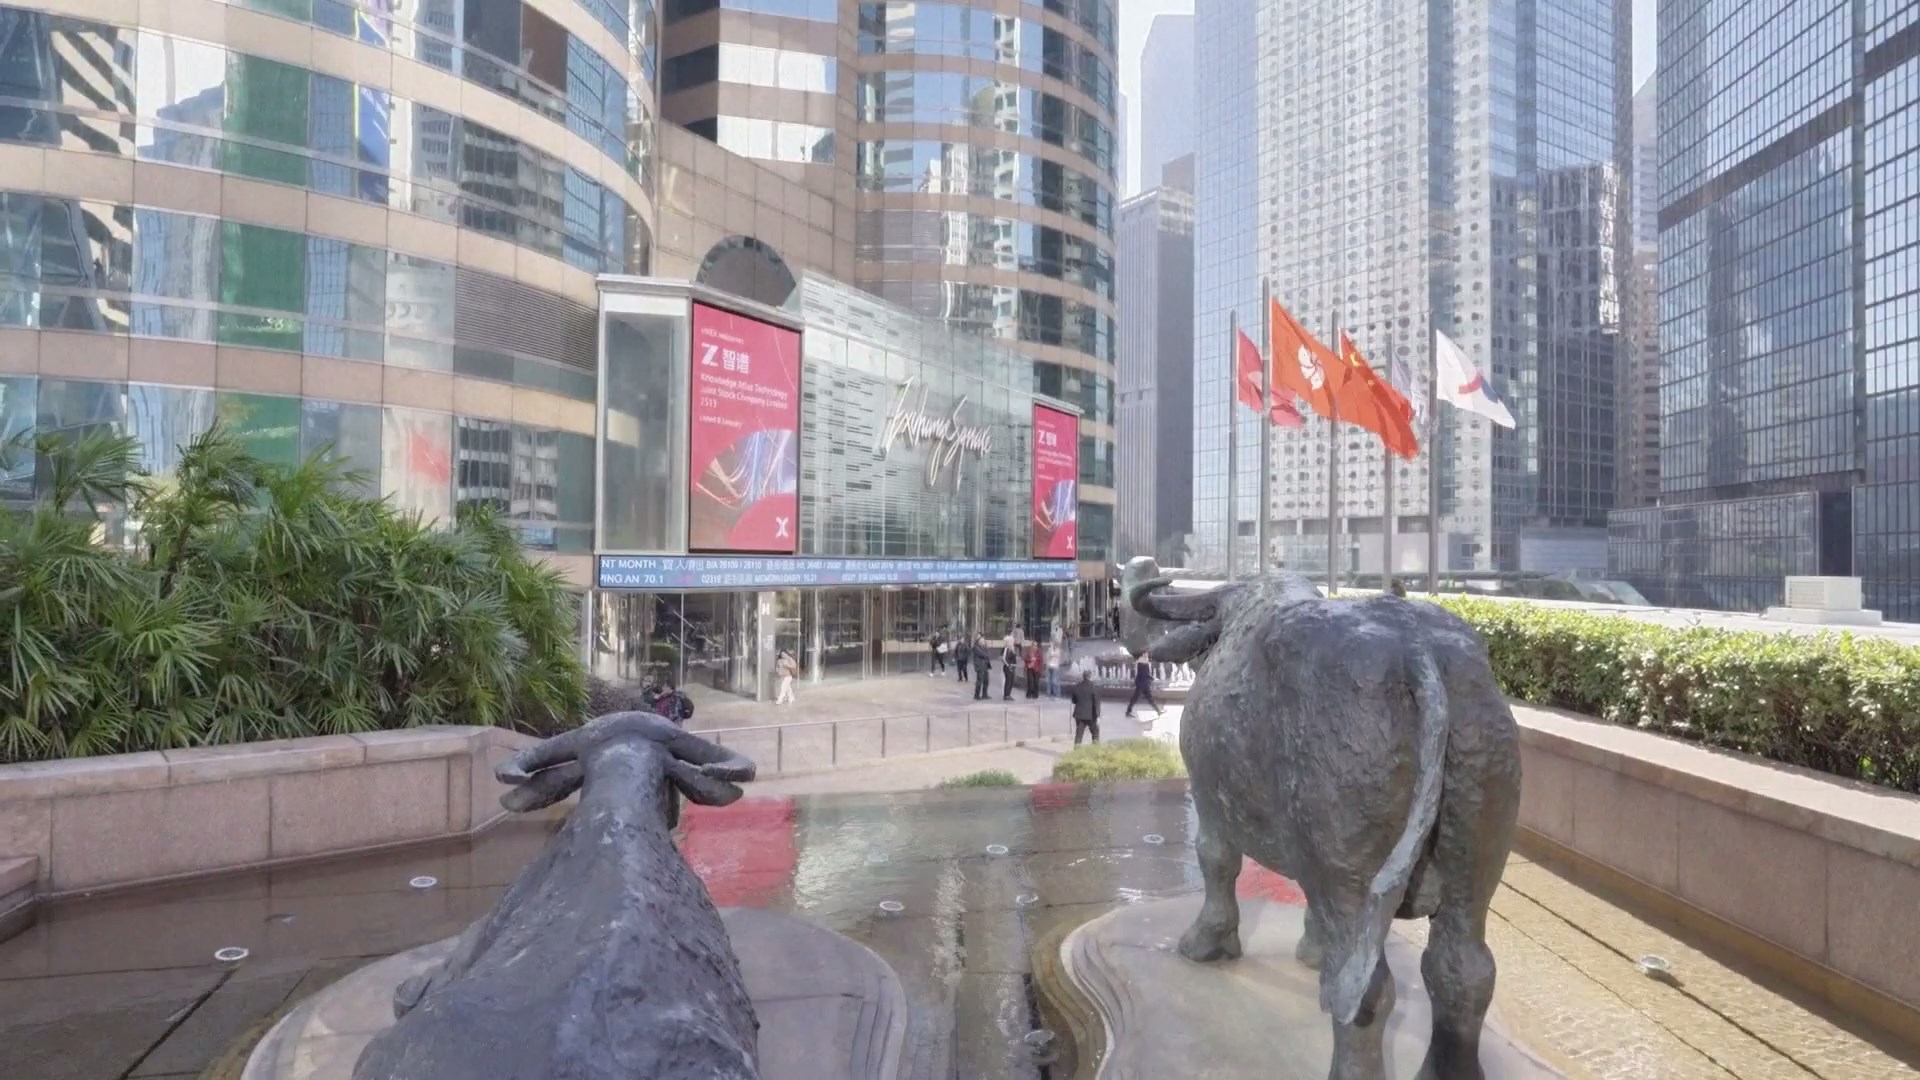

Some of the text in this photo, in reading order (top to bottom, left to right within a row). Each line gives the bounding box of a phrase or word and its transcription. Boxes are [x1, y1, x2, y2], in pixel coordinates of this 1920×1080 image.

[700, 373, 737, 389] Knowledge
[755, 383, 788, 400] Technology
[717, 388, 736, 400] Stock
[736, 391, 766, 408] Company
[601, 559, 616, 569] NT
[618, 559, 657, 569] MONTH
[624, 574, 640, 584] AN
